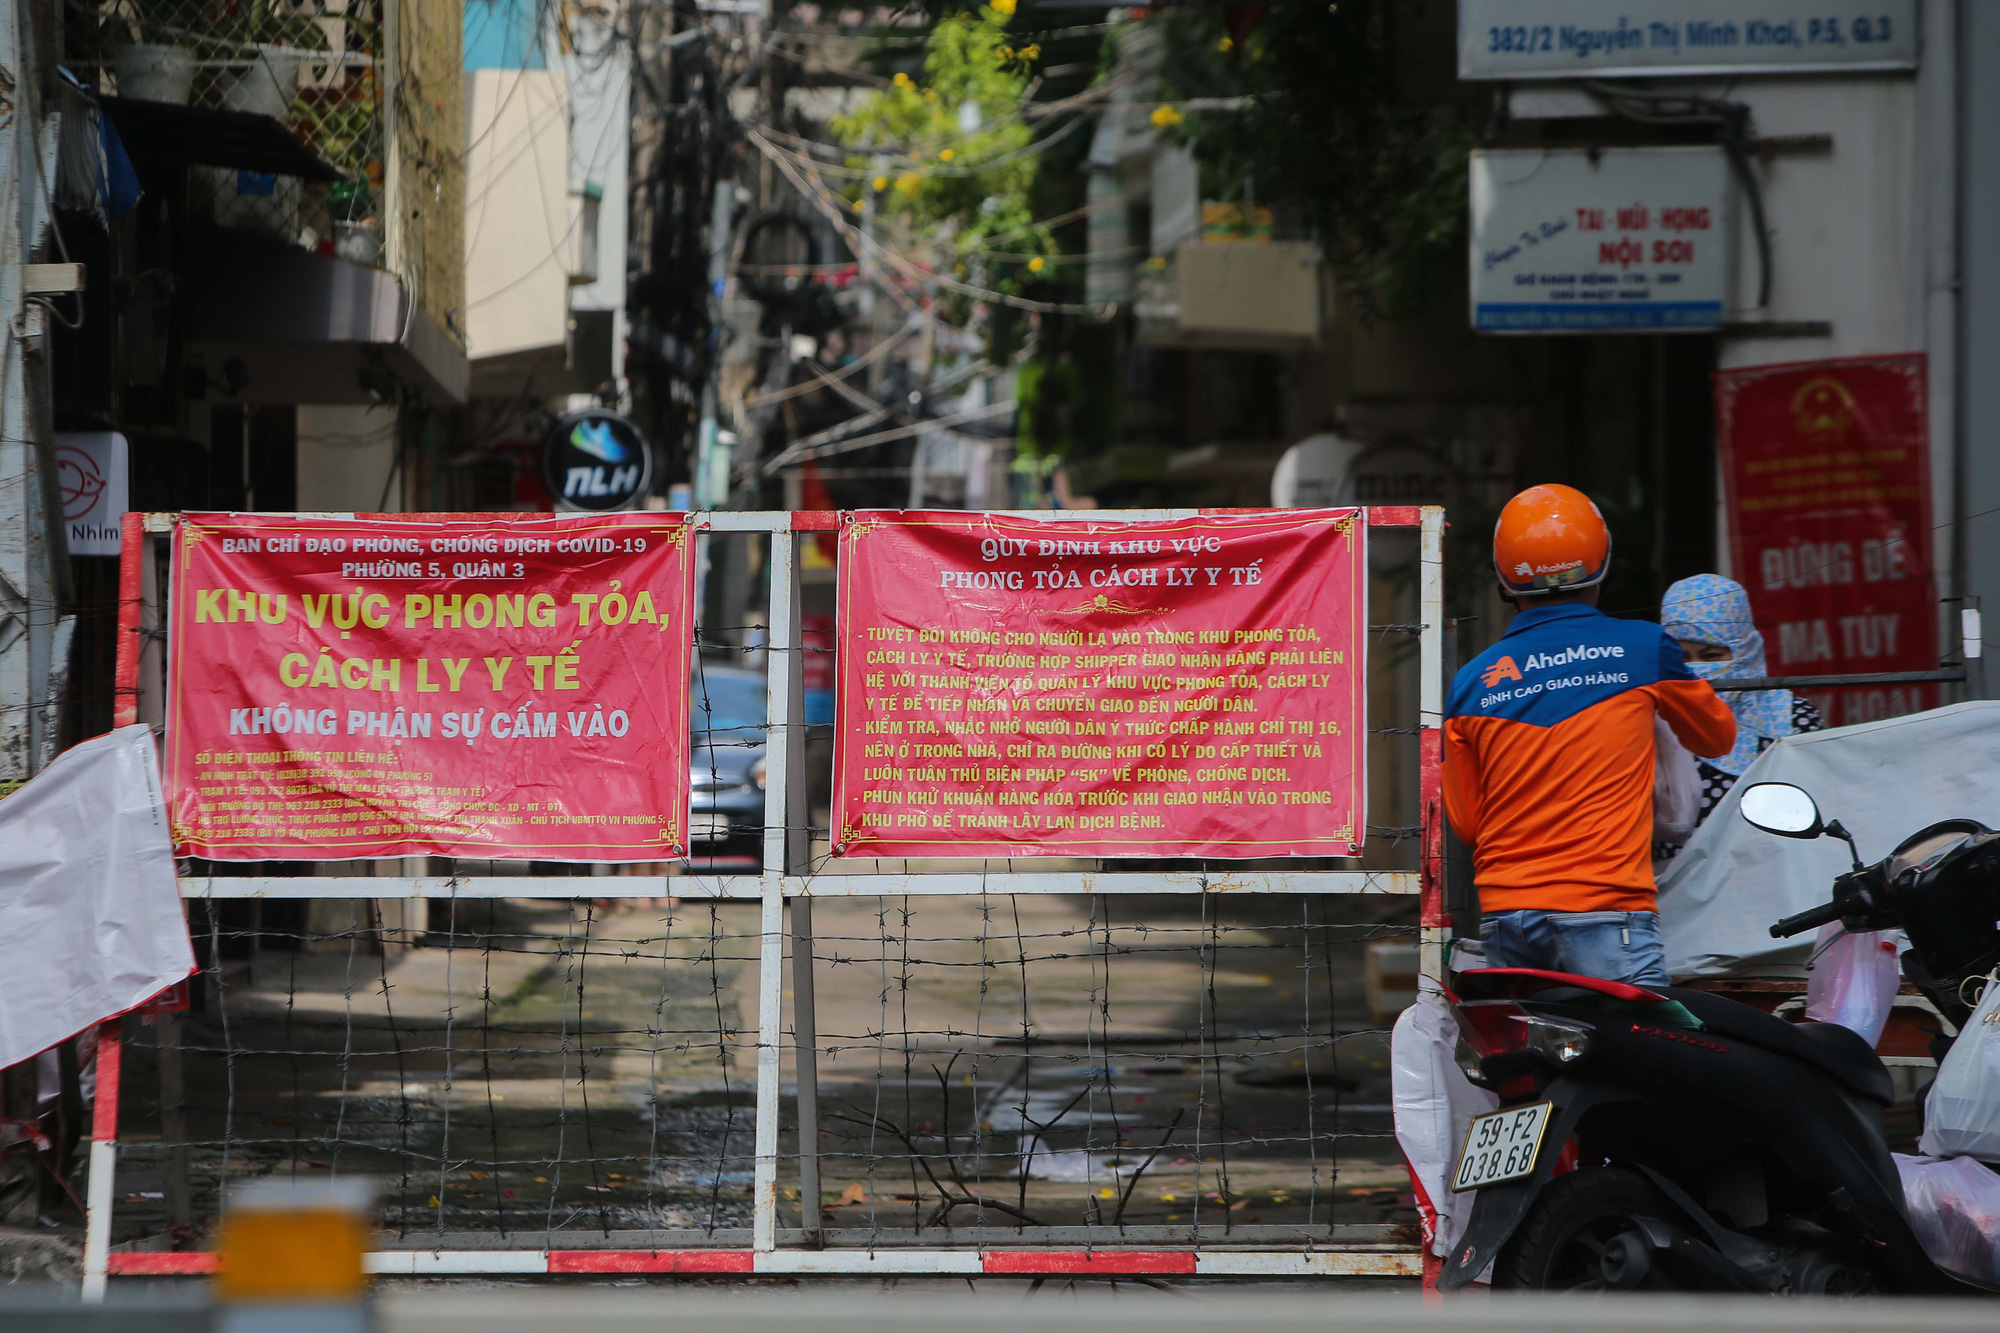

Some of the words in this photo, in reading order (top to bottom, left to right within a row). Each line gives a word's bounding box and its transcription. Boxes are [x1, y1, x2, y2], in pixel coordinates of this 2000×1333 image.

[1488, 26, 1553, 53] 382/2
[1558, 16, 1644, 58] Nguyễn
[1648, 22, 1680, 56] Thị
[1687, 21, 1739, 49] Minh
[1745, 18, 1803, 49] Khai,
[1598, 236, 1643, 270] NỘI
[1651, 239, 1694, 264] SOI
[564, 464, 638, 498] NLH
[222, 538, 267, 553] BAN
[269, 534, 300, 553] CHỈ
[305, 538, 348, 556] ĐẠO
[352, 536, 425, 555] PHÒNG,
[430, 533, 498, 553] CHỐNG
[504, 538, 550, 556] DỊCH
[556, 537, 647, 553] COVID-19
[981, 537, 1030, 562] QUY
[1039, 539, 1101, 560] ĐỊNH
[1109, 539, 1162, 555] KHU
[1170, 535, 1221, 557] VỰC
[1762, 538, 1854, 590] ĐỪNG
[1862, 521, 1906, 582] ĐỂ
[341, 560, 423, 577] PHƯỜNG
[428, 562, 447, 580] 5,
[452, 560, 506, 581] QUẬN
[511, 562, 525, 578] 3
[940, 570, 1024, 589] PHONG
[1032, 563, 1082, 589] TỎA
[1089, 564, 1158, 588] CÁCH
[1167, 568, 1202, 586] LY
[1205, 568, 1223, 586] Y
[1229, 557, 1263, 586] TẾ
[1535, 560, 1583, 574] AhaMove
[195, 588, 287, 624] KHU
[301, 585, 390, 639] VỰC
[404, 593, 558, 629] PHONG
[571, 579, 670, 631] TỎA,
[867, 625, 915, 643] TUYỆT
[919, 625, 945, 643] ĐỐI
[950, 628, 1001, 645] KHÔNG
[1004, 632, 1035, 646] CHO
[1039, 628, 1084, 646] NGƯỜI
[1088, 632, 1107, 647] LẠ
[1112, 629, 1142, 645] VÀO
[1145, 631, 1195, 644] TRONG
[1199, 630, 1230, 644] KHU
[1234, 626, 1285, 644] PHONG
[1286, 624, 1321, 642] TỎA,
[1780, 619, 1832, 665] MA
[1839, 606, 1900, 659] TÚY
[279, 646, 401, 693] CÁCH
[416, 657, 474, 693] LY
[478, 657, 514, 691] Y
[526, 640, 583, 691] TẾ
[866, 648, 906, 664] CÁCH
[911, 652, 928, 665] LY
[933, 653, 943, 666] Y
[948, 648, 972, 668] TẾ,
[976, 652, 1037, 668] TRƯỜNG
[1040, 654, 1071, 671] HỢP
[1075, 654, 1138, 668] SHIPPER
[1142, 653, 1176, 667] GIAO
[1180, 650, 1222, 670] NHẬN
[1226, 650, 1267, 666] HÀNG
[1270, 647, 1305, 665] PHẢI
[1309, 647, 1344, 664] LIÊN
[1524, 644, 1625, 672] AhaMove
[1514, 683, 1543, 699] CAO
[1546, 676, 1583, 691] GIAO
[1585, 671, 1629, 686] HÀNG
[229, 702, 337, 735] KHÔNG
[347, 706, 431, 745] PHẬN
[440, 706, 484, 745] SỰ
[490, 700, 556, 739] CẤM
[566, 703, 630, 738] VÀO
[865, 714, 903, 734] KIỂM
[906, 720, 940, 736] TRA,
[945, 716, 985, 734] NHẮC
[989, 716, 1022, 734] NHỞ
[1025, 718, 1070, 735] NGƯỜI
[1075, 718, 1106, 735] DÂN
[1110, 719, 1120, 736] Ý
[1125, 719, 1165, 736] THỨC
[1169, 716, 1210, 735] CHẤP
[1213, 719, 1255, 735] HÀNH
[1259, 716, 1285, 734] CHỈ
[1288, 721, 1314, 737] THỊ
[1320, 721, 1342, 736] 16,
[195, 749, 212, 765] SỐ
[214, 750, 243, 766] ĐIỆN
[246, 751, 281, 766] THOẠI
[283, 748, 322, 763] THÔNG
[325, 751, 344, 763] TIN
[347, 749, 375, 763] LIÊN
[378, 750, 399, 765] HỆ:
[864, 764, 903, 780] LUÔN
[906, 765, 947, 782] TUÂN
[950, 762, 981, 782] THỦ
[985, 764, 1022, 784] BIỆN
[1026, 765, 1067, 782] PHÁP
[1070, 769, 1108, 782] “5K”
[1112, 763, 1132, 782] VỀ
[1137, 765, 1192, 784] PHÒNG,
[1196, 764, 1248, 782] CHỐNG
[1251, 768, 1292, 784] DỊCH.
[862, 789, 902, 804] PHUN
[907, 787, 940, 805] KHỬ
[942, 785, 994, 806] KHUẨN
[998, 788, 1040, 805] HÀNG
[1043, 789, 1075, 806] HÓA
[1077, 788, 1129, 806] TRƯỚC
[1133, 792, 1159, 806] KHI
[1163, 791, 1198, 805] GIAO
[1202, 787, 1243, 806] NHẬN
[1247, 788, 1278, 805] VÀO
[1281, 791, 1332, 805] TRONG
[862, 813, 892, 827] KHU
[897, 810, 928, 827] PHỐ
[932, 808, 954, 827] ĐỂ
[957, 812, 1008, 828] TRÁNH
[1012, 811, 1041, 828] LÂY
[1046, 816, 1075, 829] LAN
[1079, 816, 1115, 832] DỊCH
[1119, 812, 1165, 830] BỆNH.
[1477, 1108, 1538, 1149] 59-F2
[1459, 1142, 1534, 1186] 038.68
